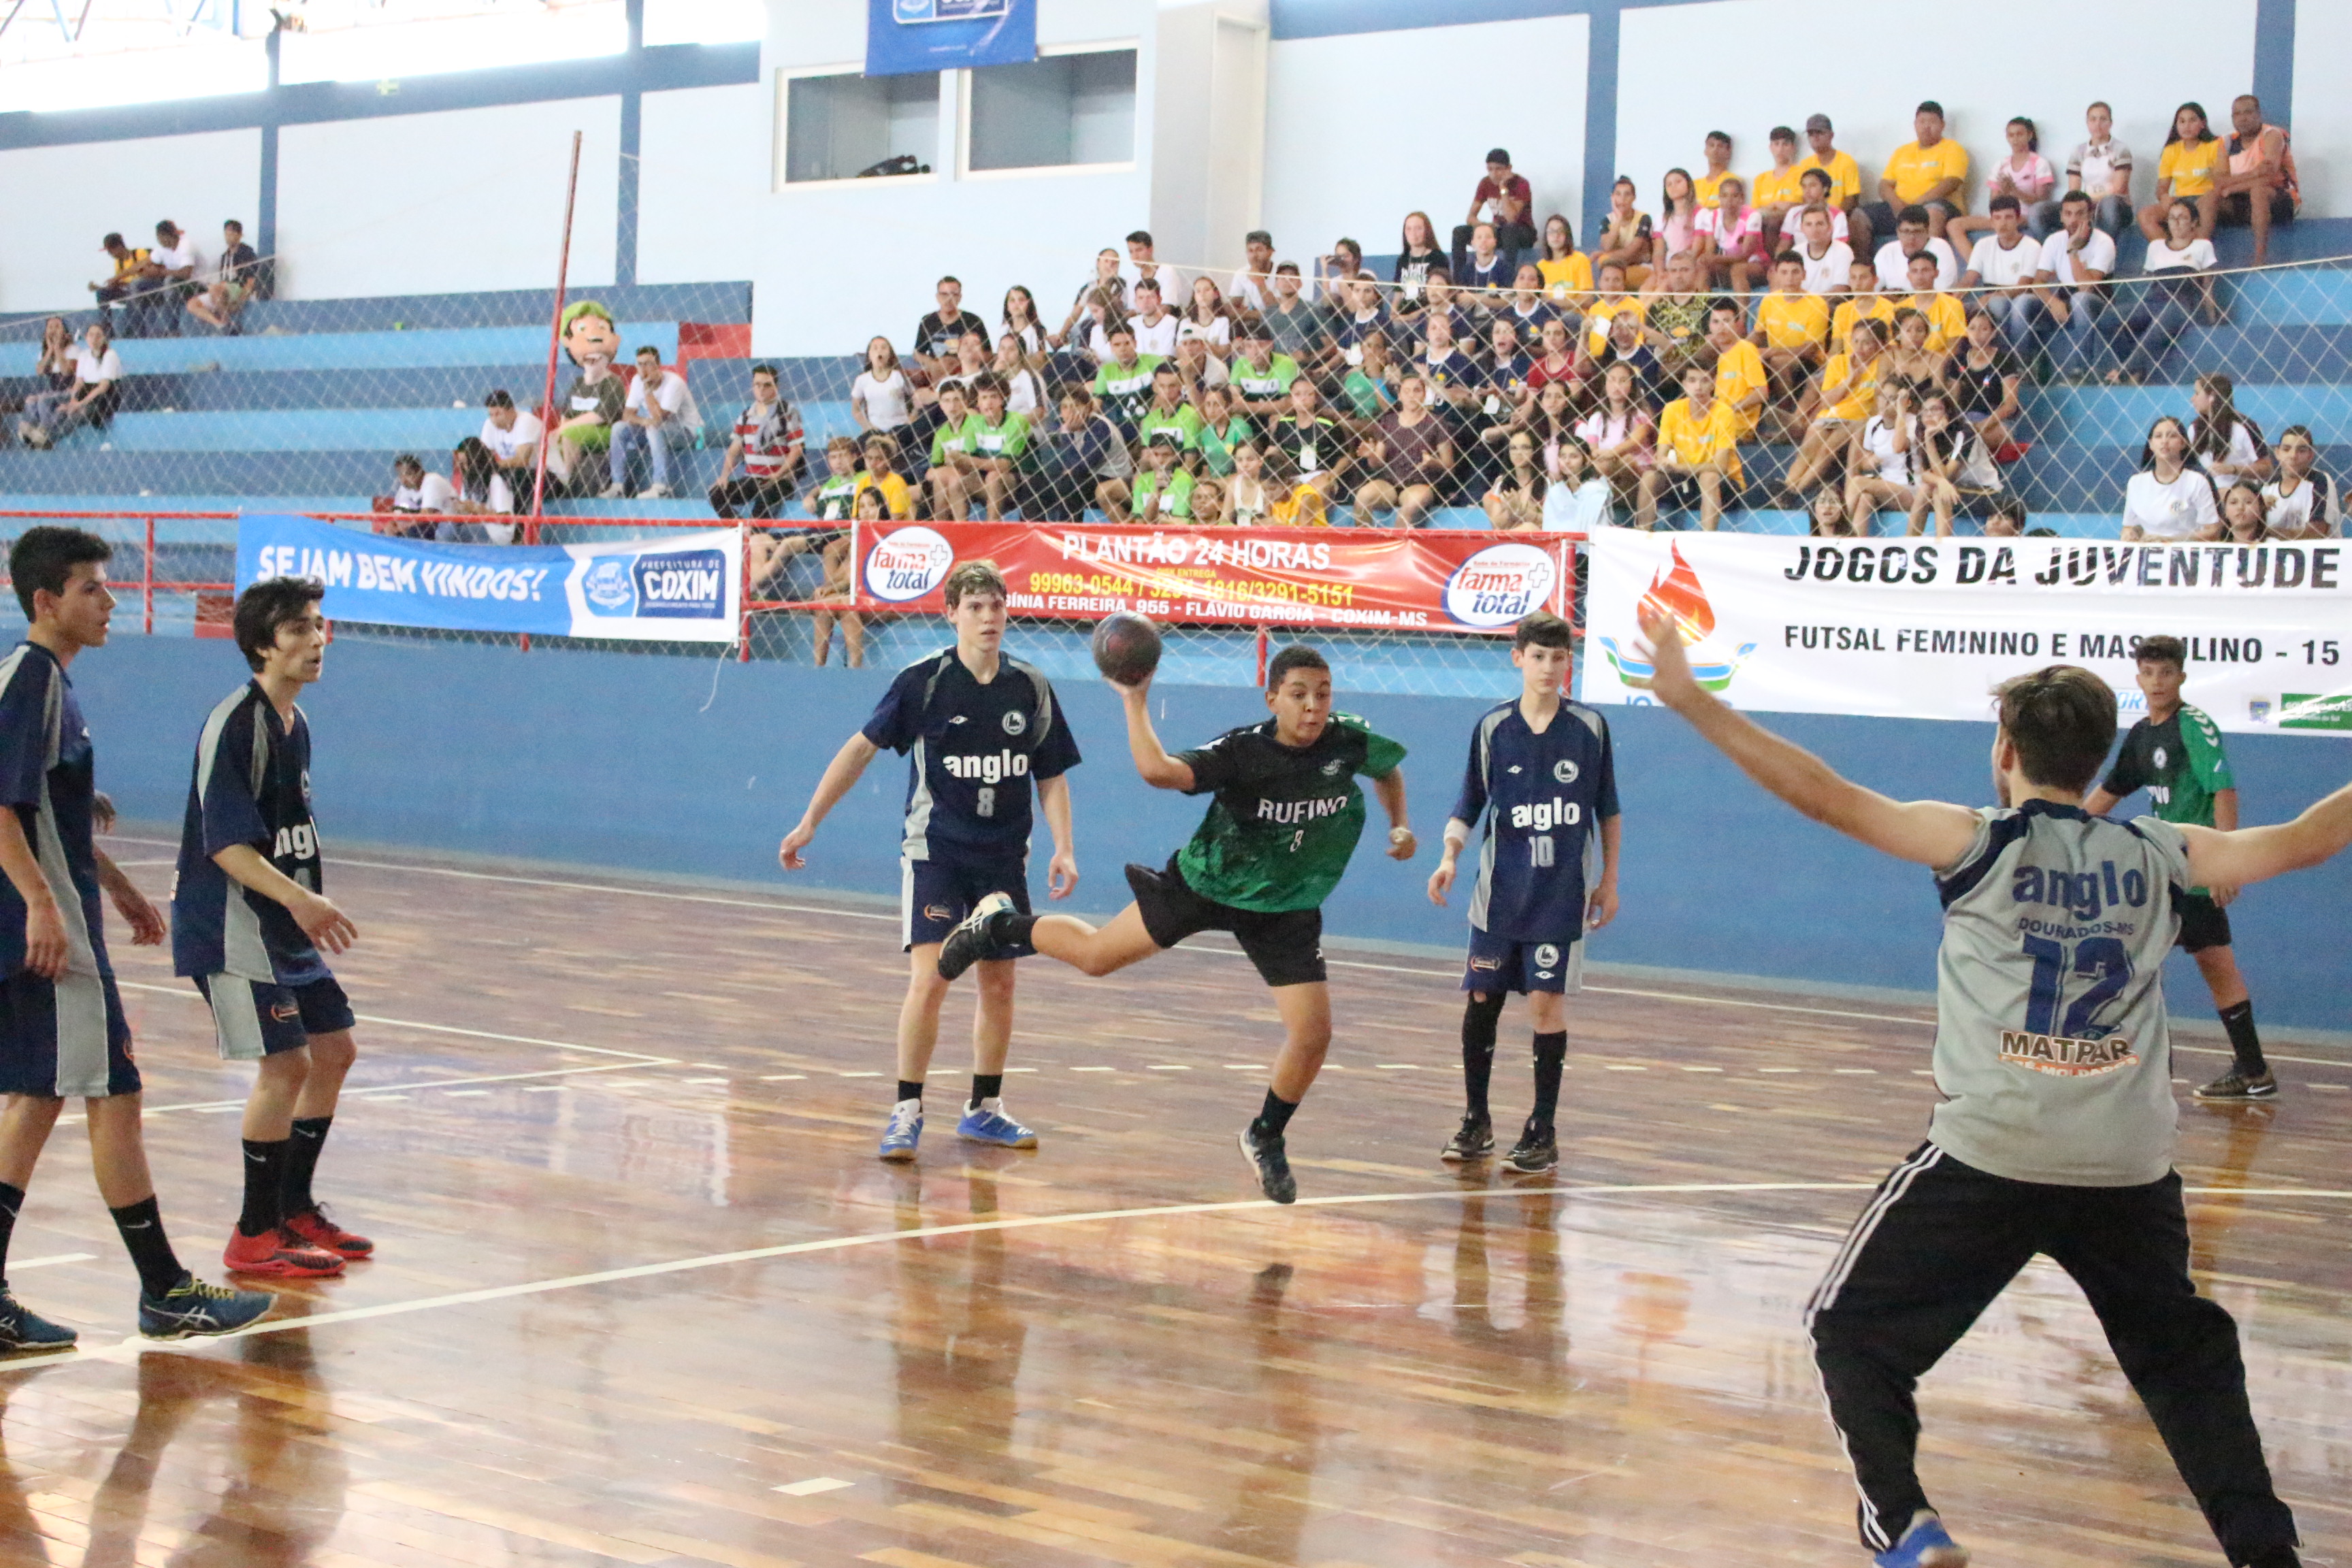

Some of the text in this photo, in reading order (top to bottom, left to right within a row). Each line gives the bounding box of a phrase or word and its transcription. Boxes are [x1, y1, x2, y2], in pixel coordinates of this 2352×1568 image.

[641, 559, 720, 570] PREFEITURA DE
[874, 547, 926, 570] farma
[1062, 532, 1330, 570] PLANTÃO 24 HORAS
[257, 545, 549, 602] SEJAM BEM VINDOS!
[887, 568, 932, 590] total
[1457, 568, 1523, 592] farma
[1784, 546, 2340, 589] JOGOS DA JUVENTUDE
[643, 570, 719, 601] COXIM
[1030, 572, 1134, 597] 99963-0544
[1137, 599, 1169, 615] 955
[1186, 601, 1245, 617] FLÁVIO
[1331, 609, 1428, 626] COXIM-MS
[1472, 590, 1531, 615] total
[1785, 625, 1886, 651] FUTSAL
[1897, 629, 2039, 657] FEMININO
[2052, 633, 2068, 657] E
[2080, 634, 2263, 664] MASLINO
[2302, 640, 2340, 666] 15
[943, 749, 1028, 783] anglo
[977, 787, 995, 817] 8
[1258, 796, 1348, 823] RUFINO
[1529, 836, 1554, 867] 10
[2012, 860, 2148, 921] anglo
[2019, 917, 2135, 940] DOURADOS-MS
[2023, 933, 2135, 1039] 12
[2000, 1030, 2136, 1064] MATPAR
